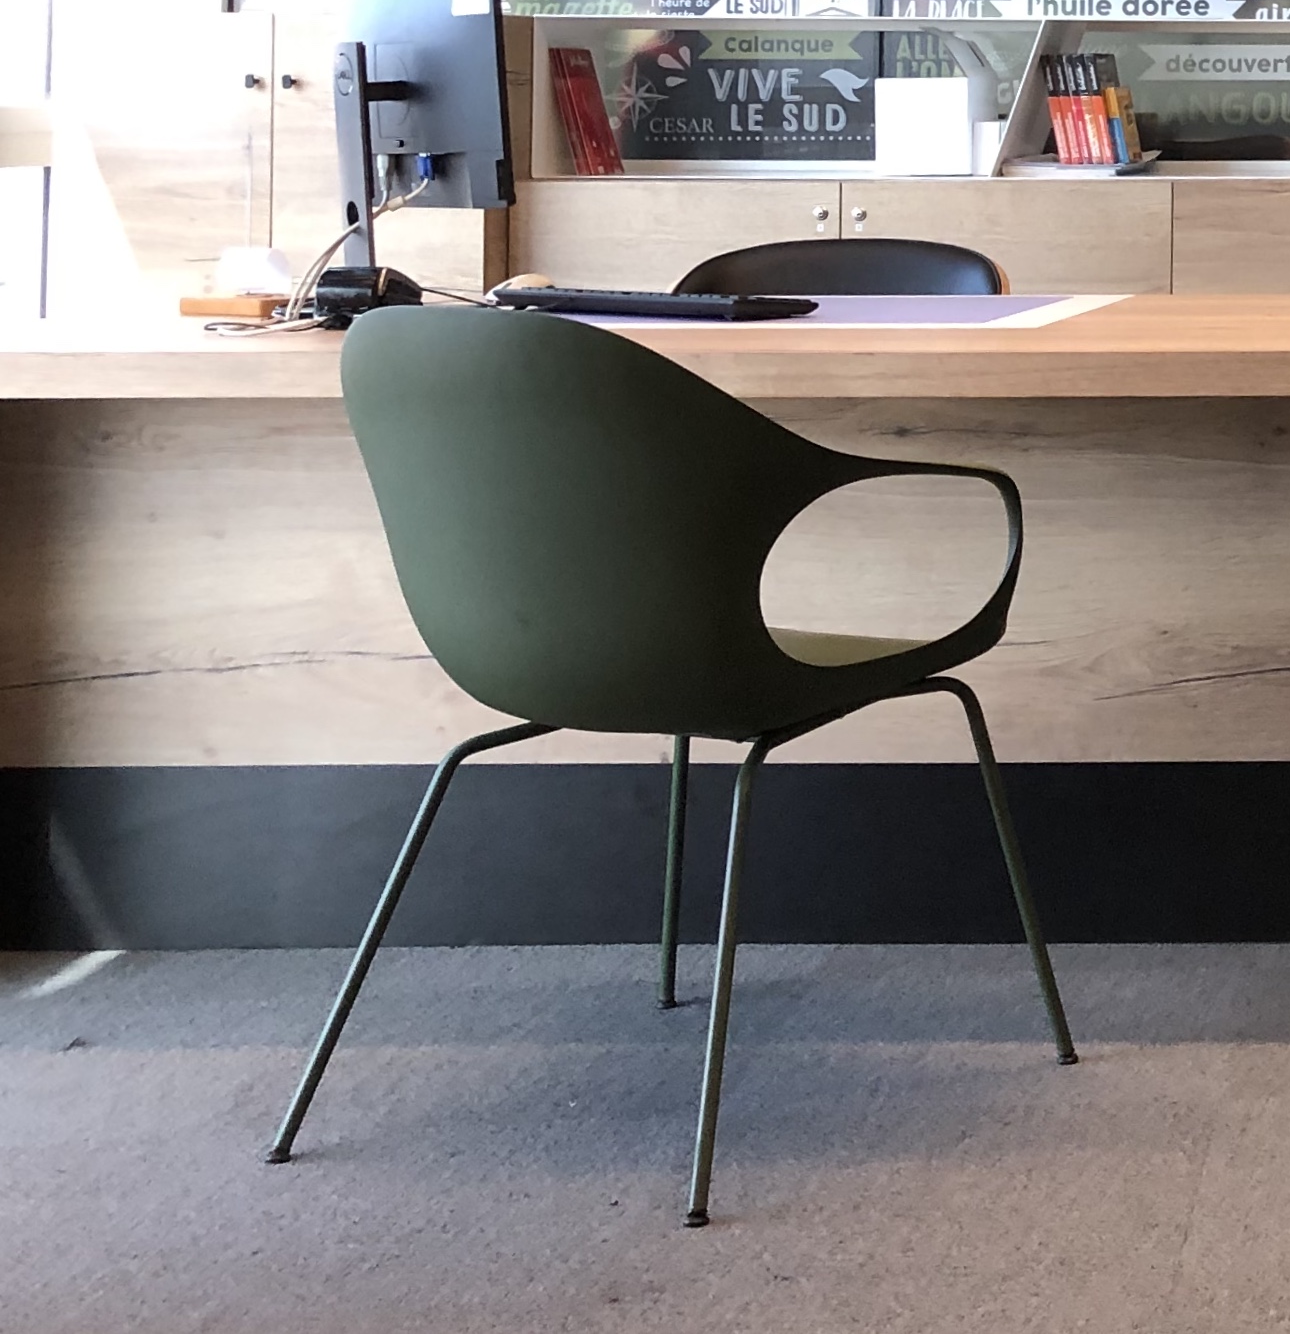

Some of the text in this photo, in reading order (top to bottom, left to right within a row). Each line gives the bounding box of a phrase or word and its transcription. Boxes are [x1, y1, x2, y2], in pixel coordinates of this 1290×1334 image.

[724, 35, 834, 57] Calanque
[707, 68, 803, 102] VIVE
[649, 118, 715, 134] CESAR
[731, 104, 847, 132] LE SUD
